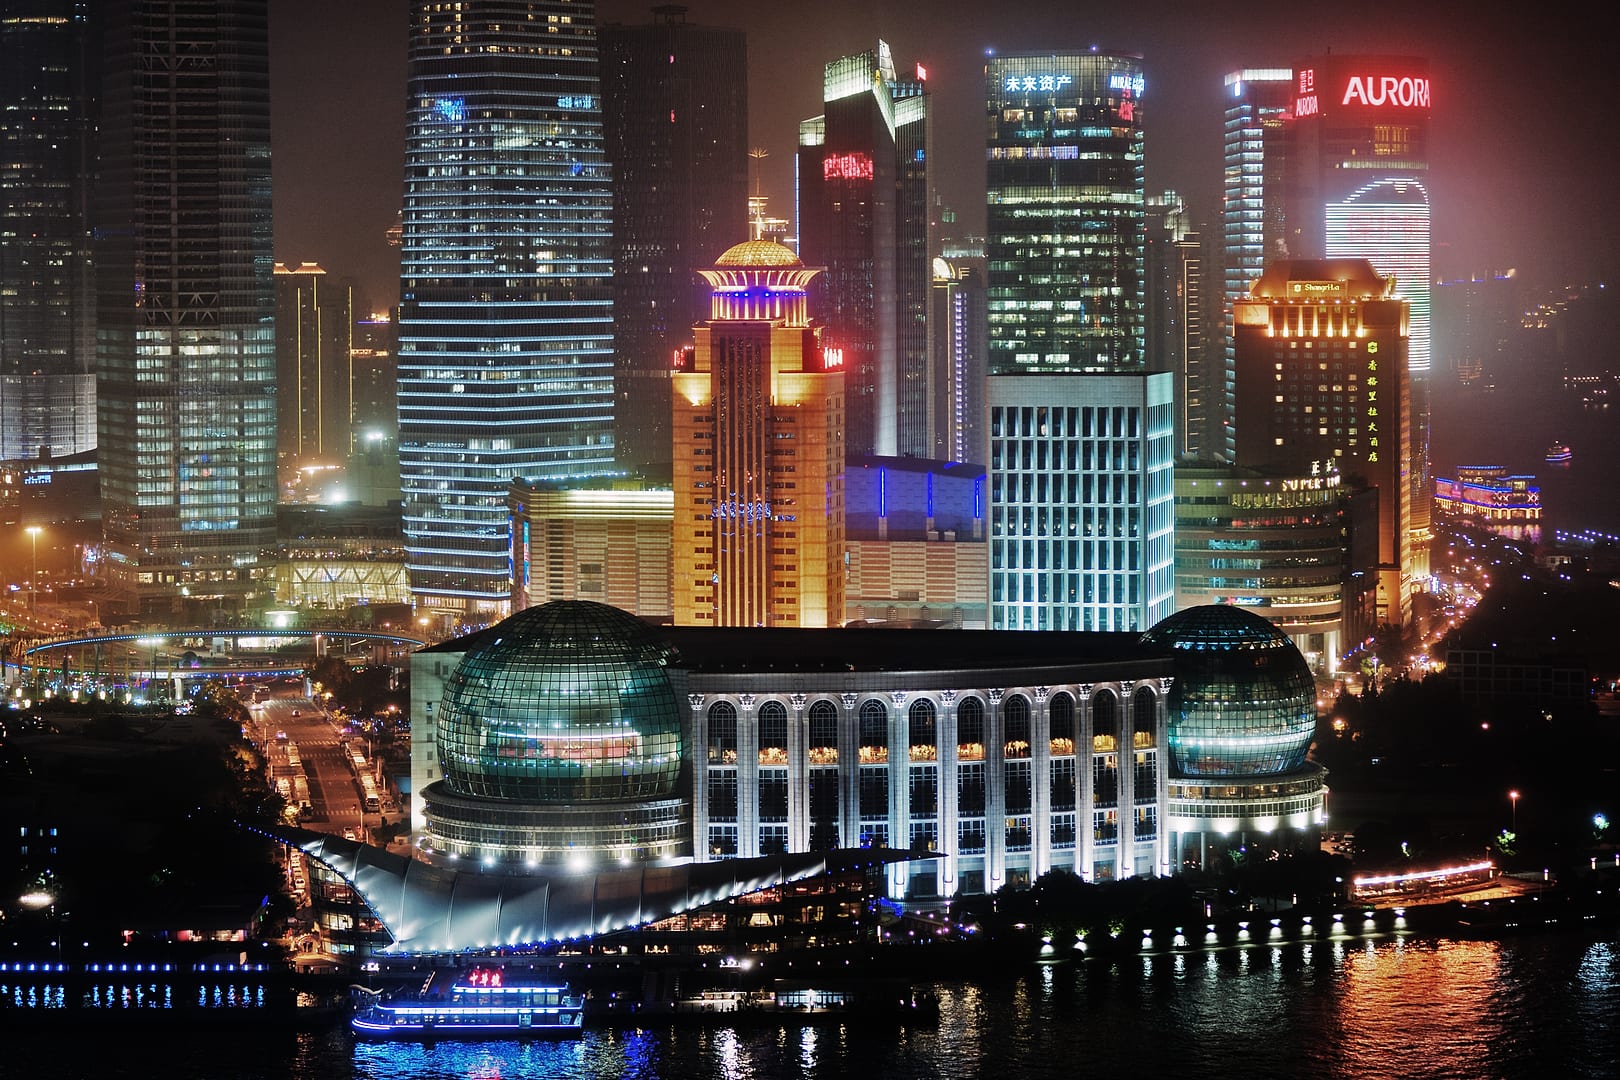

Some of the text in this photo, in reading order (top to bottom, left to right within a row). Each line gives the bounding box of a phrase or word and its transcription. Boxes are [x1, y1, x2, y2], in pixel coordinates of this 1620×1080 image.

[1006, 75, 1072, 92] 未来资产
[1110, 75, 1132, 90] MIRAE
[1342, 76, 1431, 108] AURORA
[1296, 96, 1319, 117] AURORA
[1367, 359, 1379, 462] 香格里拉大酒店
[1281, 477, 1321, 493] SUPER
